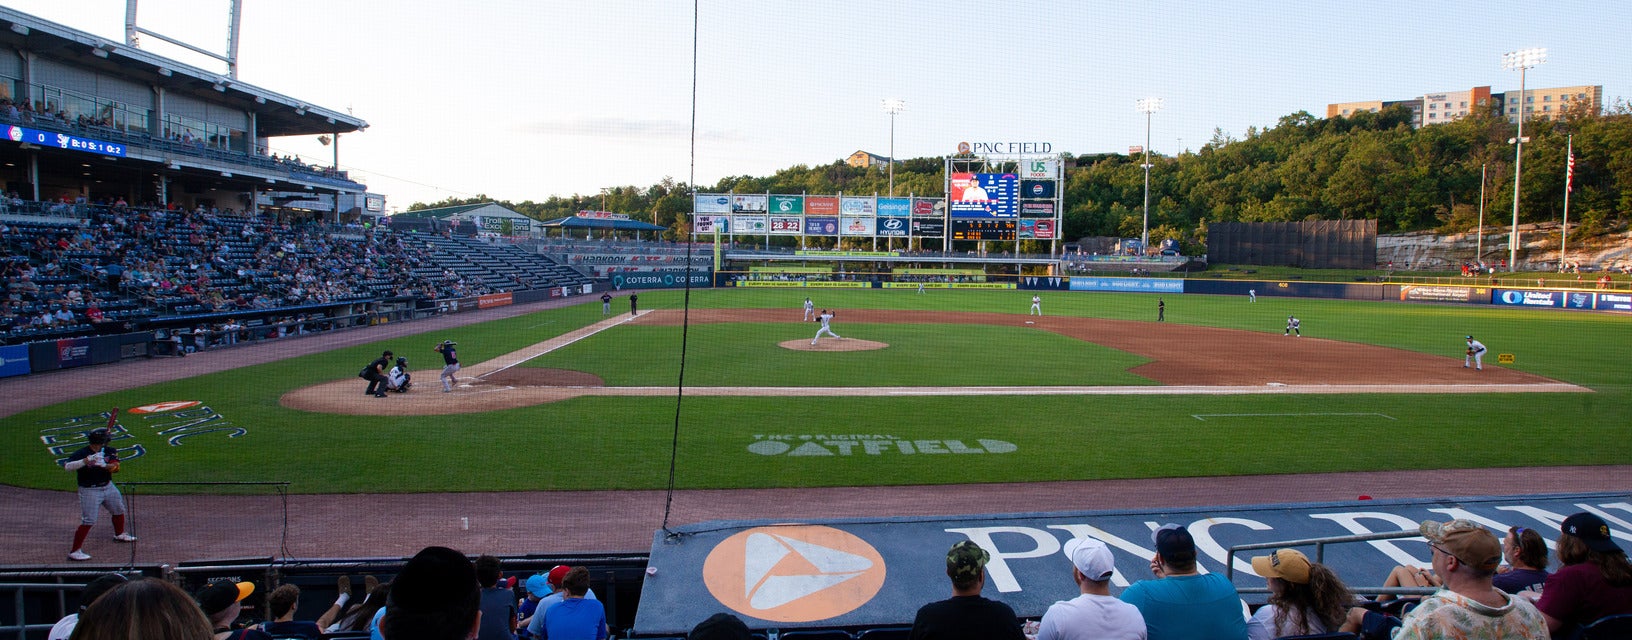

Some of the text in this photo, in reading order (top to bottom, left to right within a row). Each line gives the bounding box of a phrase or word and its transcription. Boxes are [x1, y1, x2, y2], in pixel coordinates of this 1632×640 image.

[38, 134, 44, 142] 0
[973, 142, 1052, 153] PNC FIELD
[878, 202, 909, 212] Geisinger
[944, 517, 1274, 593] PNC
